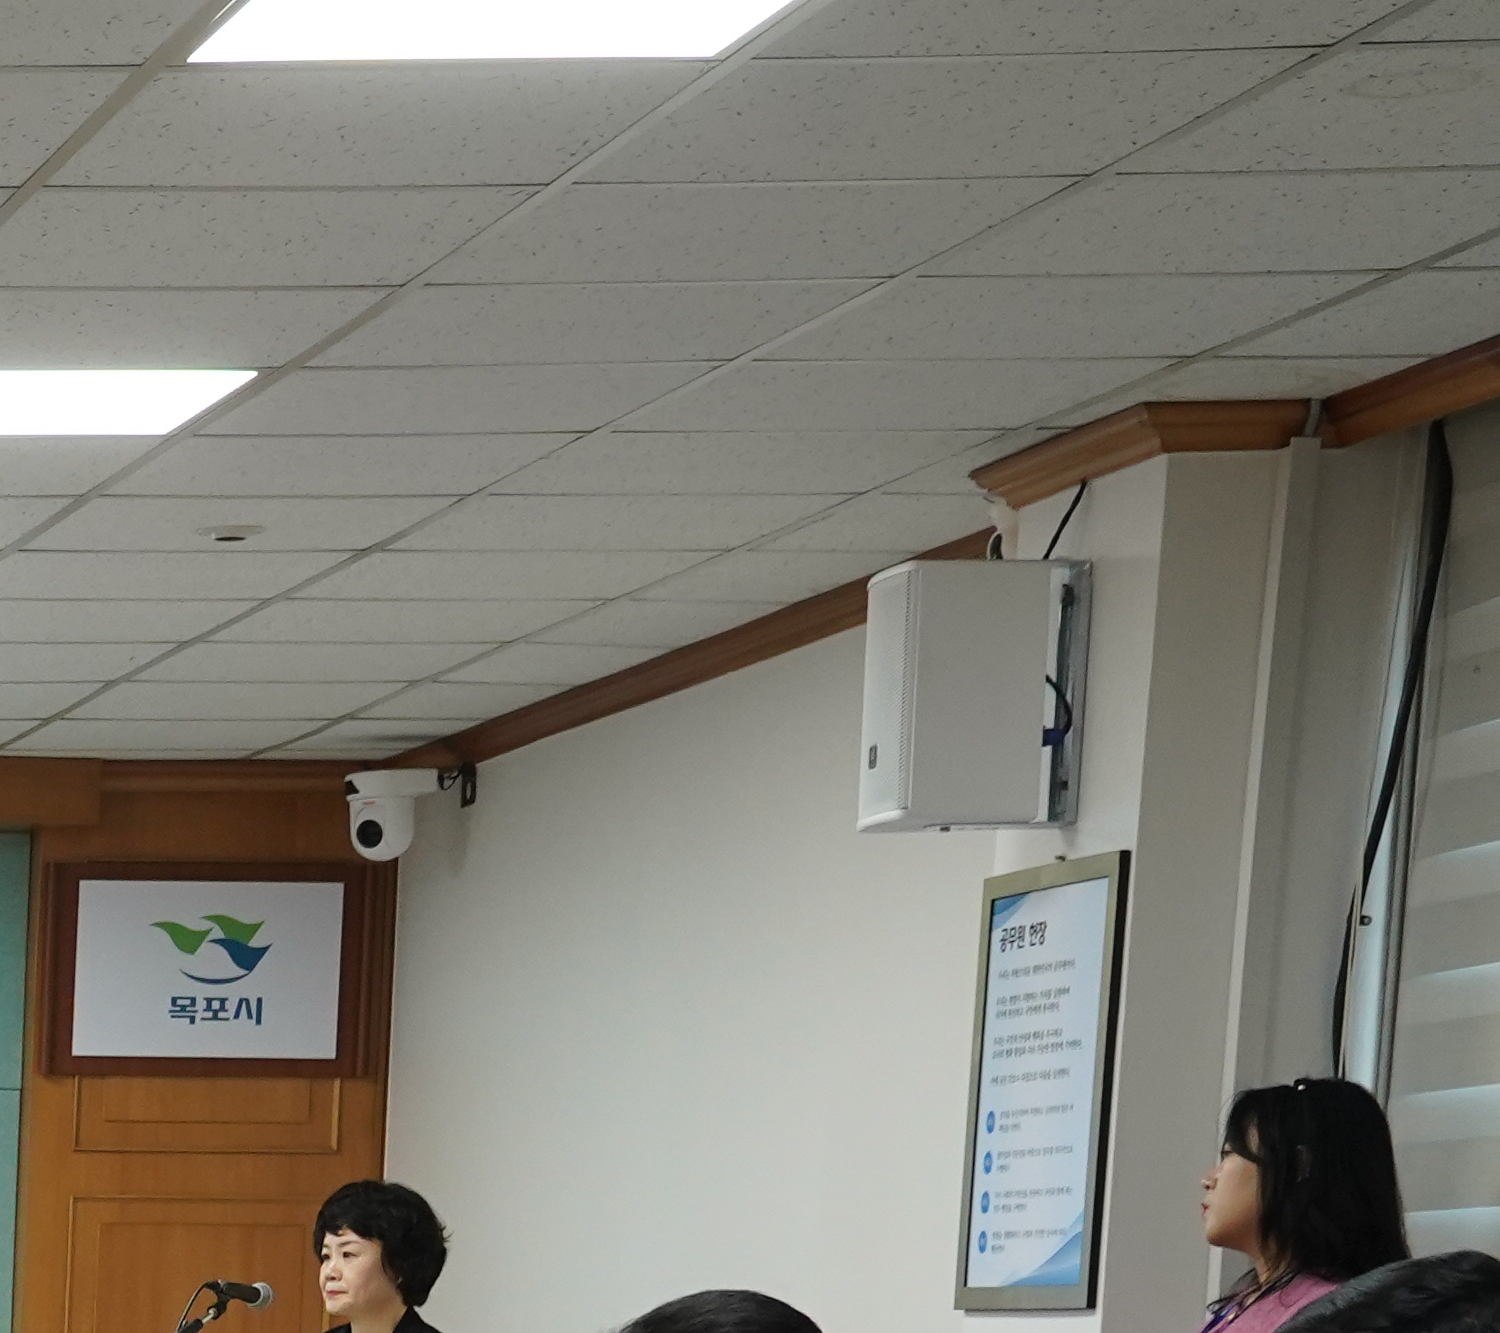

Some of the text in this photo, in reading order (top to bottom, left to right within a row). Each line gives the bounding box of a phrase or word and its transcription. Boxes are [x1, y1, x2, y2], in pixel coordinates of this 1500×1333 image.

[999, 920, 1048, 953] 공무원 헌장
[168, 996, 263, 1026] 목포시
